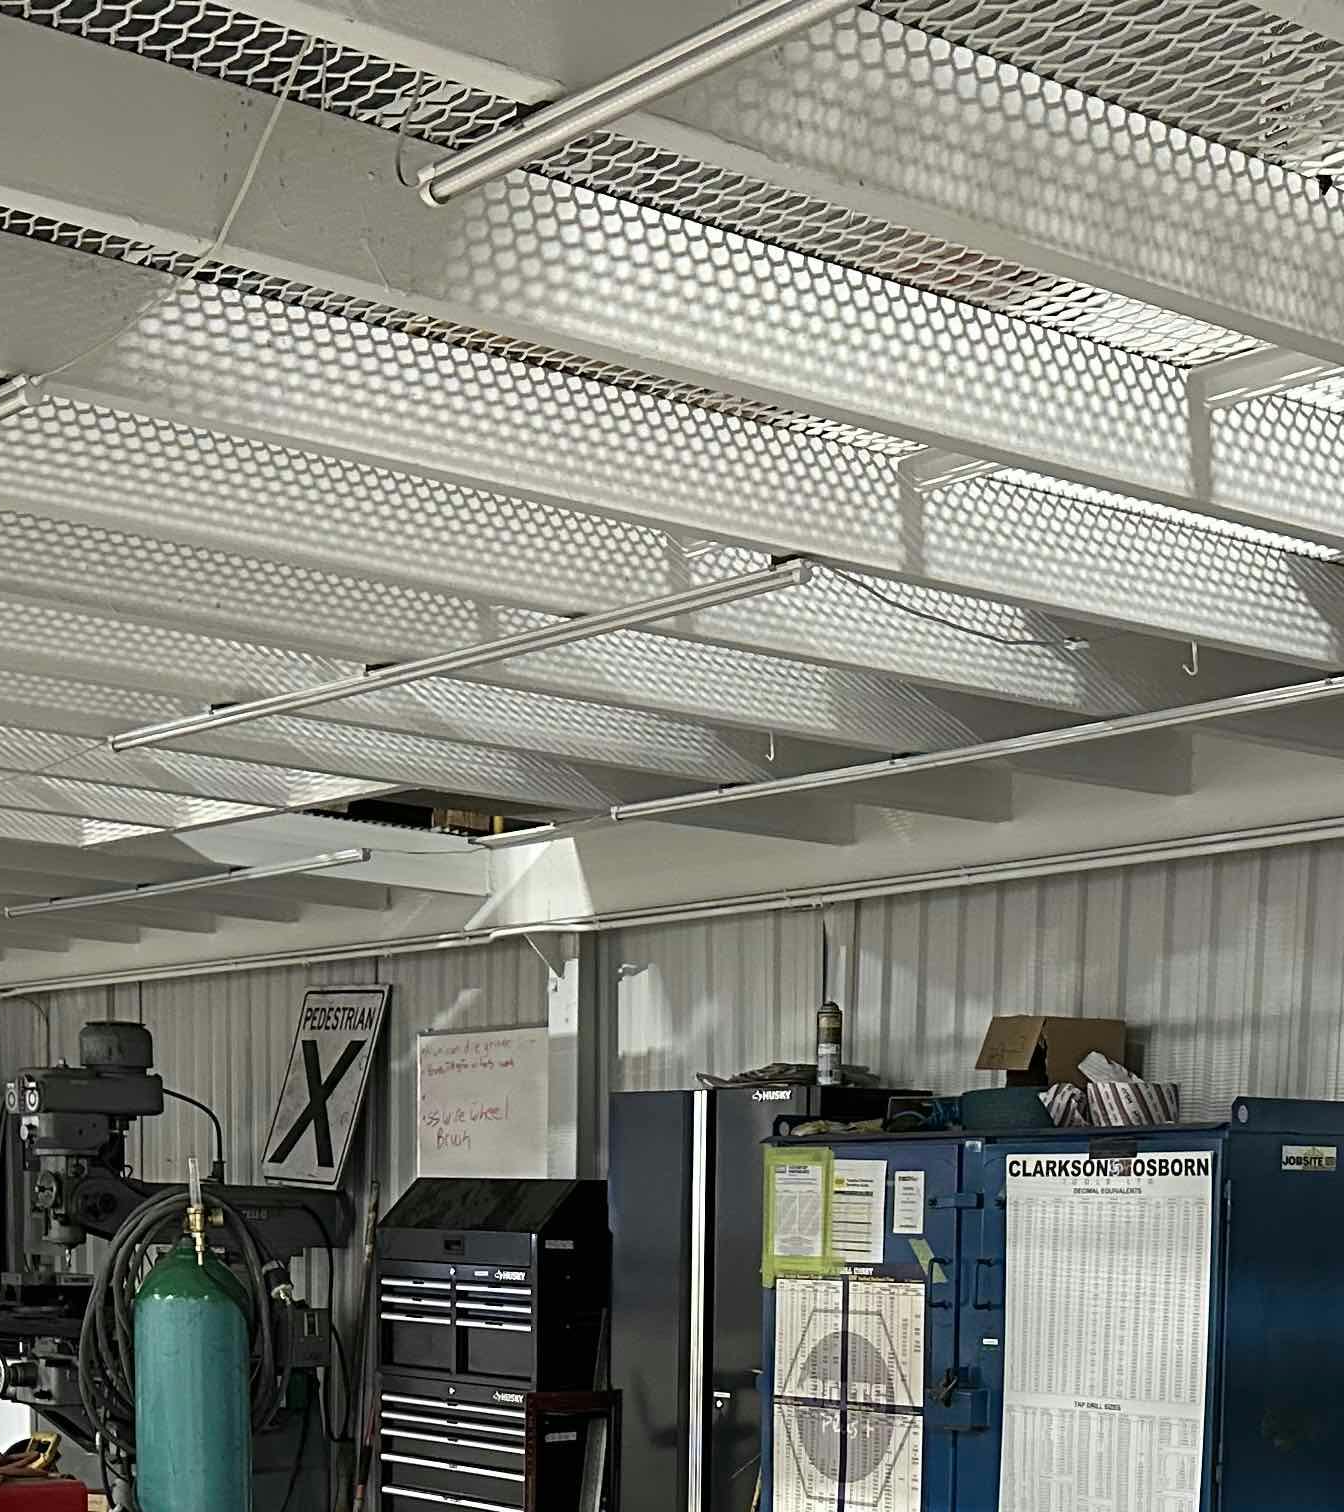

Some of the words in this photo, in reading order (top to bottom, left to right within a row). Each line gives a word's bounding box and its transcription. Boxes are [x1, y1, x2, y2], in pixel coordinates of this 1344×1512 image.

[303, 1007, 375, 1031] PEDESTRIAN
[268, 1039, 367, 1168] X
[762, 1090, 792, 1101] HUSKY
[470, 1096, 509, 1121] wheel
[1008, 1159, 1108, 1178] CLARKSON
[1133, 1158, 1209, 1177] OSBORN
[1282, 1155, 1324, 1167] JOBSITE
[501, 1272, 526, 1281] HUSKY
[499, 1393, 524, 1403] HUSKY
